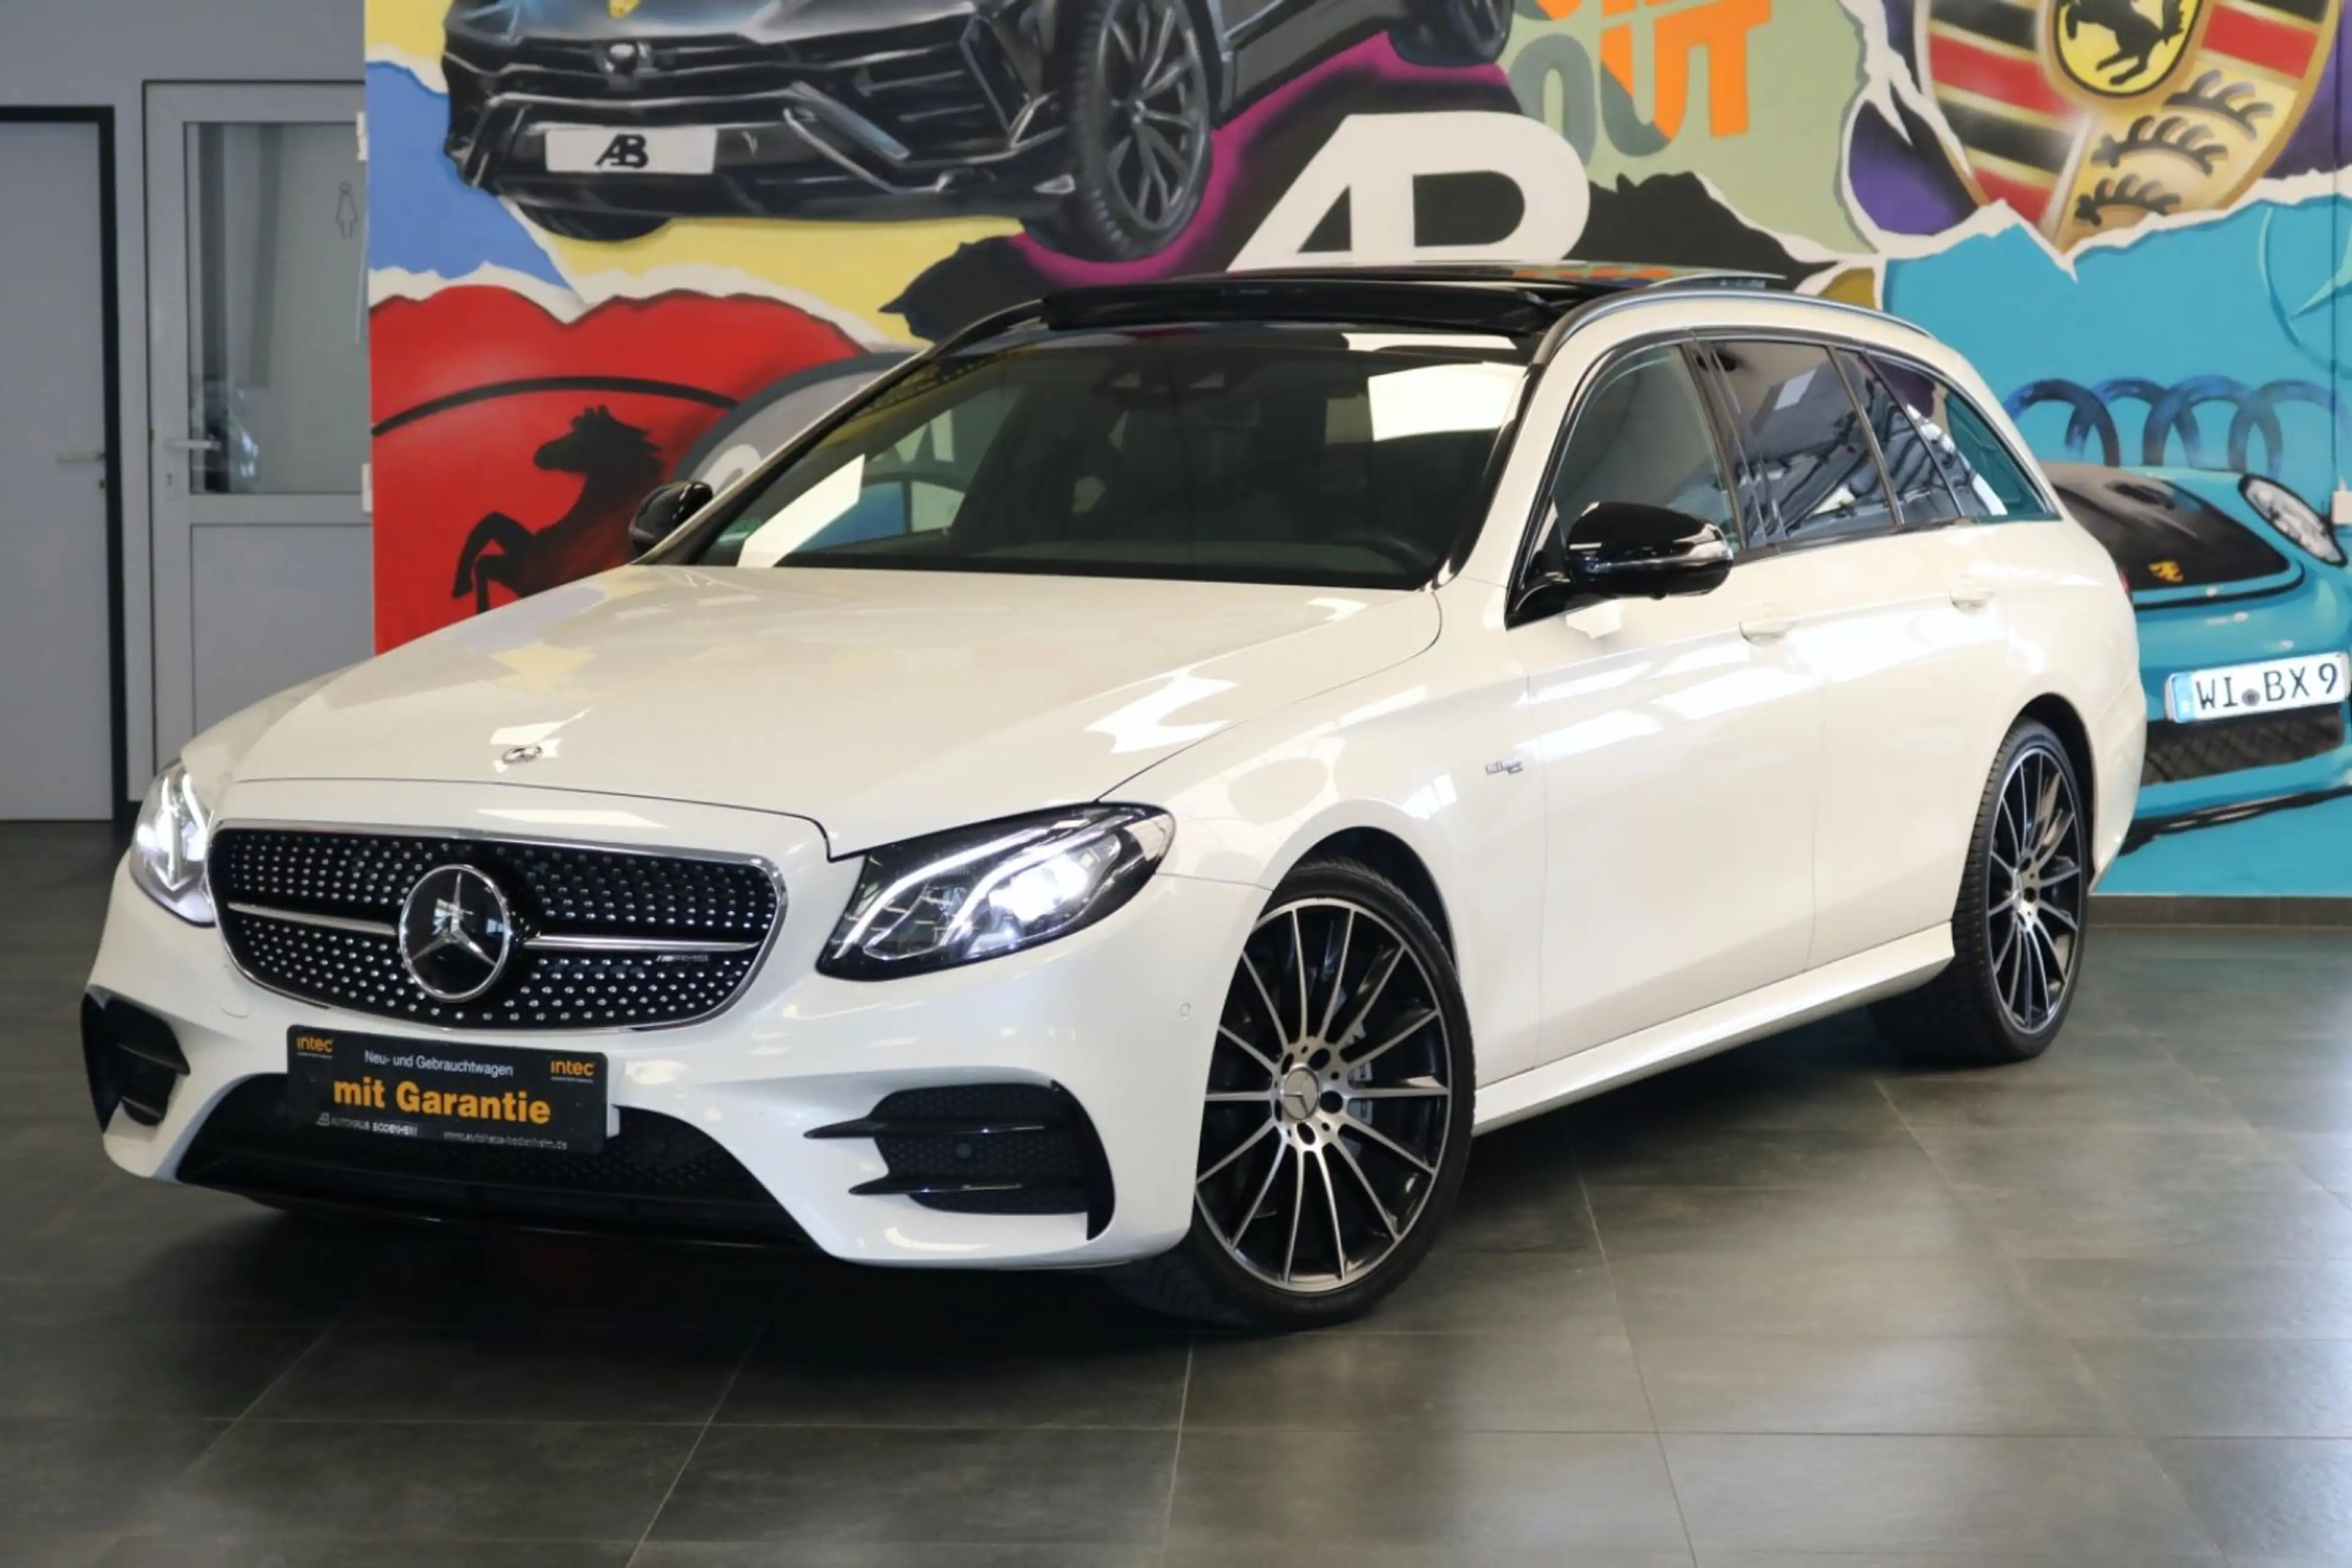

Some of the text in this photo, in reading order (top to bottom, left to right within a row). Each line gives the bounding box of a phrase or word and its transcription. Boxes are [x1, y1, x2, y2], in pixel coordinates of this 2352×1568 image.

[594, 133, 649, 169] AB
[2196, 663, 2338, 710] WI BX 9
[297, 1036, 333, 1053] intec
[364, 1050, 514, 1079] Neu- und Gebrauchtwagen
[551, 1060, 595, 1077] intec
[334, 1076, 551, 1124] mit Garantie
